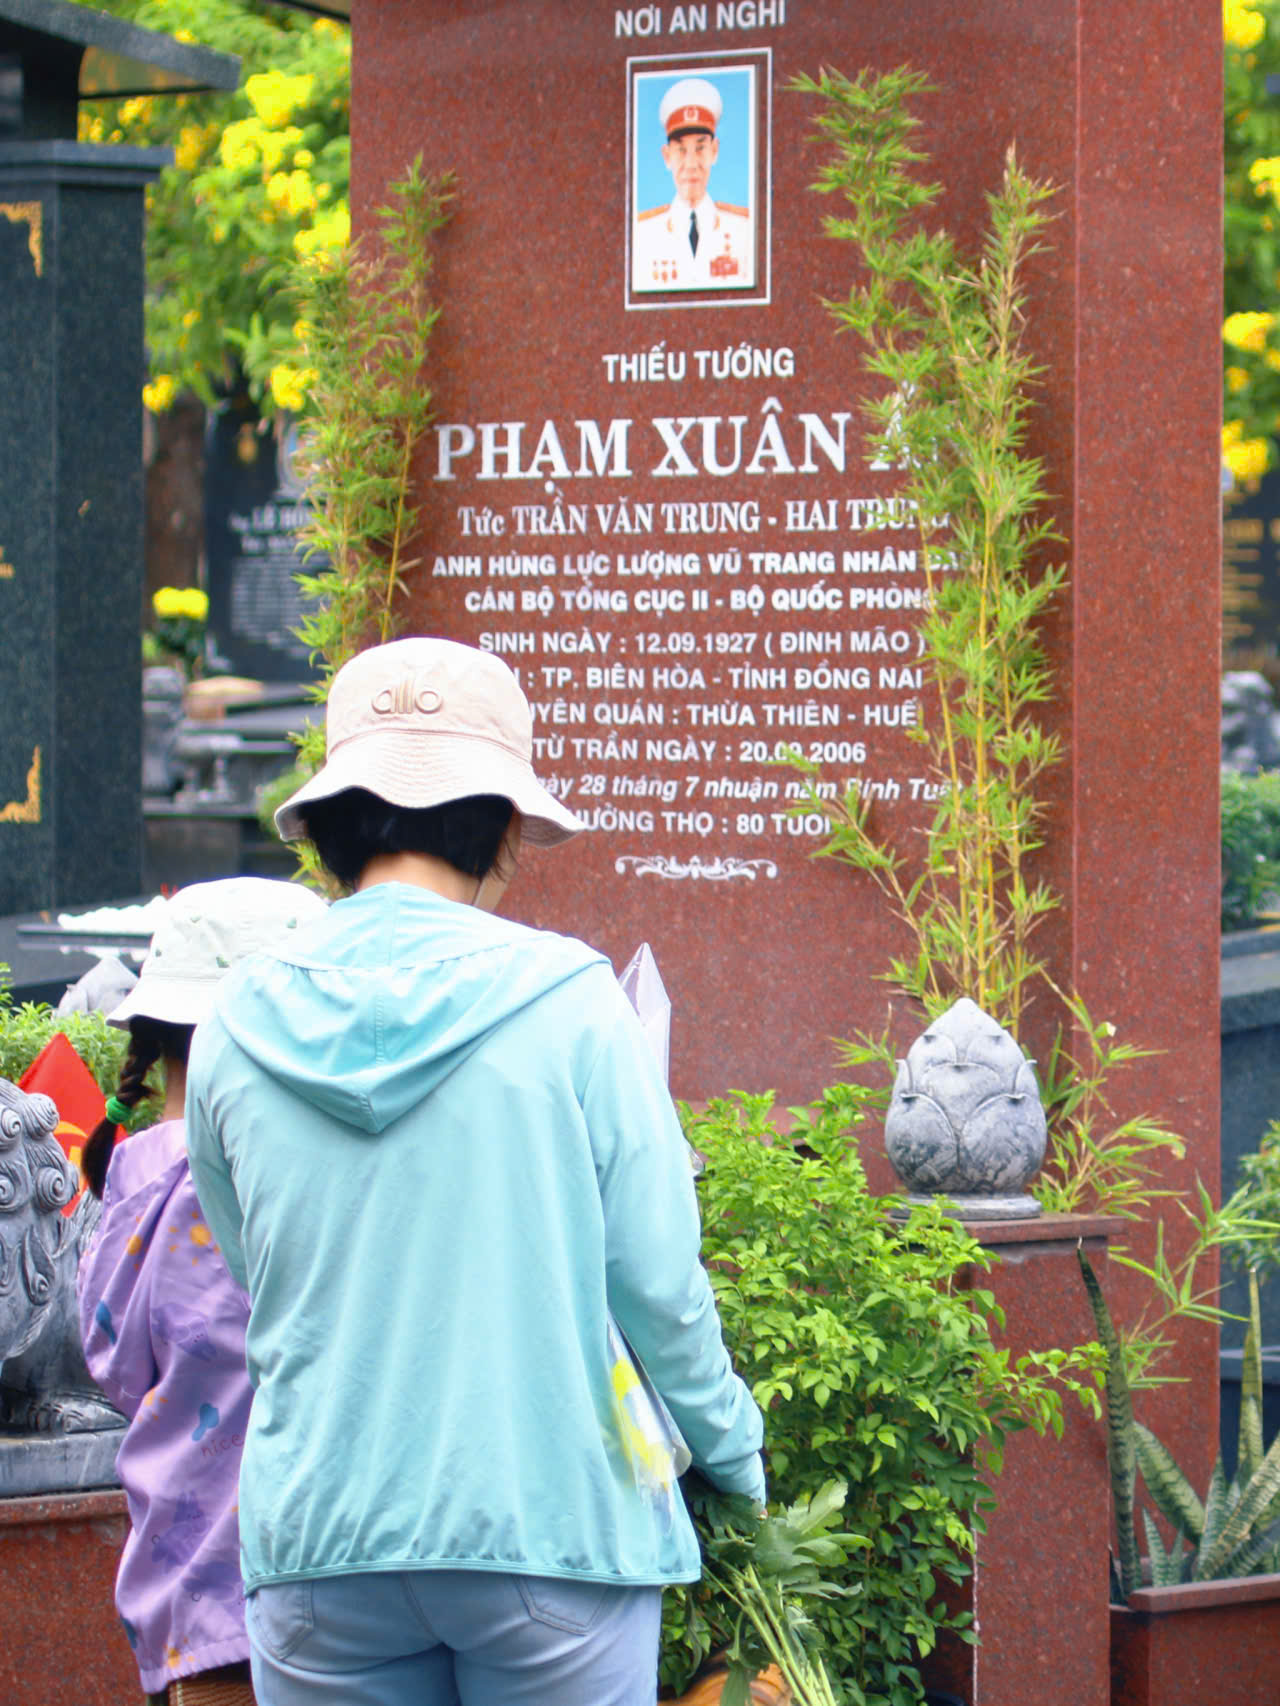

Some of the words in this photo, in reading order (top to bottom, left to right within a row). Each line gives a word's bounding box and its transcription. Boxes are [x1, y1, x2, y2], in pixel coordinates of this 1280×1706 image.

[615, 4, 661, 38] NƠI
[669, 5, 707, 34] AN
[601, 340, 686, 383] THIẾU
[693, 341, 795, 380] TƯỚNG
[432, 418, 633, 494] PHẠM
[651, 397, 852, 477] XUÂN
[457, 506, 505, 536] Tức
[512, 488, 588, 536] TRẦN
[595, 496, 653, 534] VĂN
[661, 500, 760, 534] TRUNG
[785, 499, 839, 532] HAI
[432, 555, 482, 577] ANH
[488, 549, 557, 576] HÙNG
[563, 550, 611, 581] LỰC
[617, 549, 700, 581] LƯỢNG
[708, 547, 742, 575] VŨ
[749, 551, 836, 575] TRANG
[842, 545, 918, 573] NHÂN
[464, 585, 515, 613] CÁN
[521, 585, 555, 617] BỘ
[560, 577, 628, 612] TỔNG
[634, 589, 686, 618] CỤC
[729, 584, 766, 616] BỘ
[771, 580, 843, 611] QUỐC
[478, 632, 536, 653] SINH
[542, 627, 612, 653] NGÀY
[635, 632, 757, 654] 12.09.1927
[780, 631, 842, 653] ĐINH
[850, 626, 910, 653] MÃO
[586, 662, 645, 688] BIÊN
[653, 662, 707, 688] HÒA
[728, 661, 786, 689] TỈNH
[794, 660, 871, 690] ĐỒNG
[879, 668, 923, 690] NAI
[593, 698, 664, 725] QUÁN
[686, 699, 756, 726] THỪA
[762, 700, 839, 726] THIÊN
[864, 697, 919, 725] HUẾ
[533, 733, 565, 760] TỪ
[571, 730, 638, 761] TRẦN
[646, 735, 716, 762] NGÀY
[578, 775, 606, 795] 28
[612, 774, 678, 802] tháng
[685, 777, 699, 798] 7
[704, 776, 779, 803] nhuận
[661, 811, 714, 838] THỌ
[736, 813, 764, 835] 80
